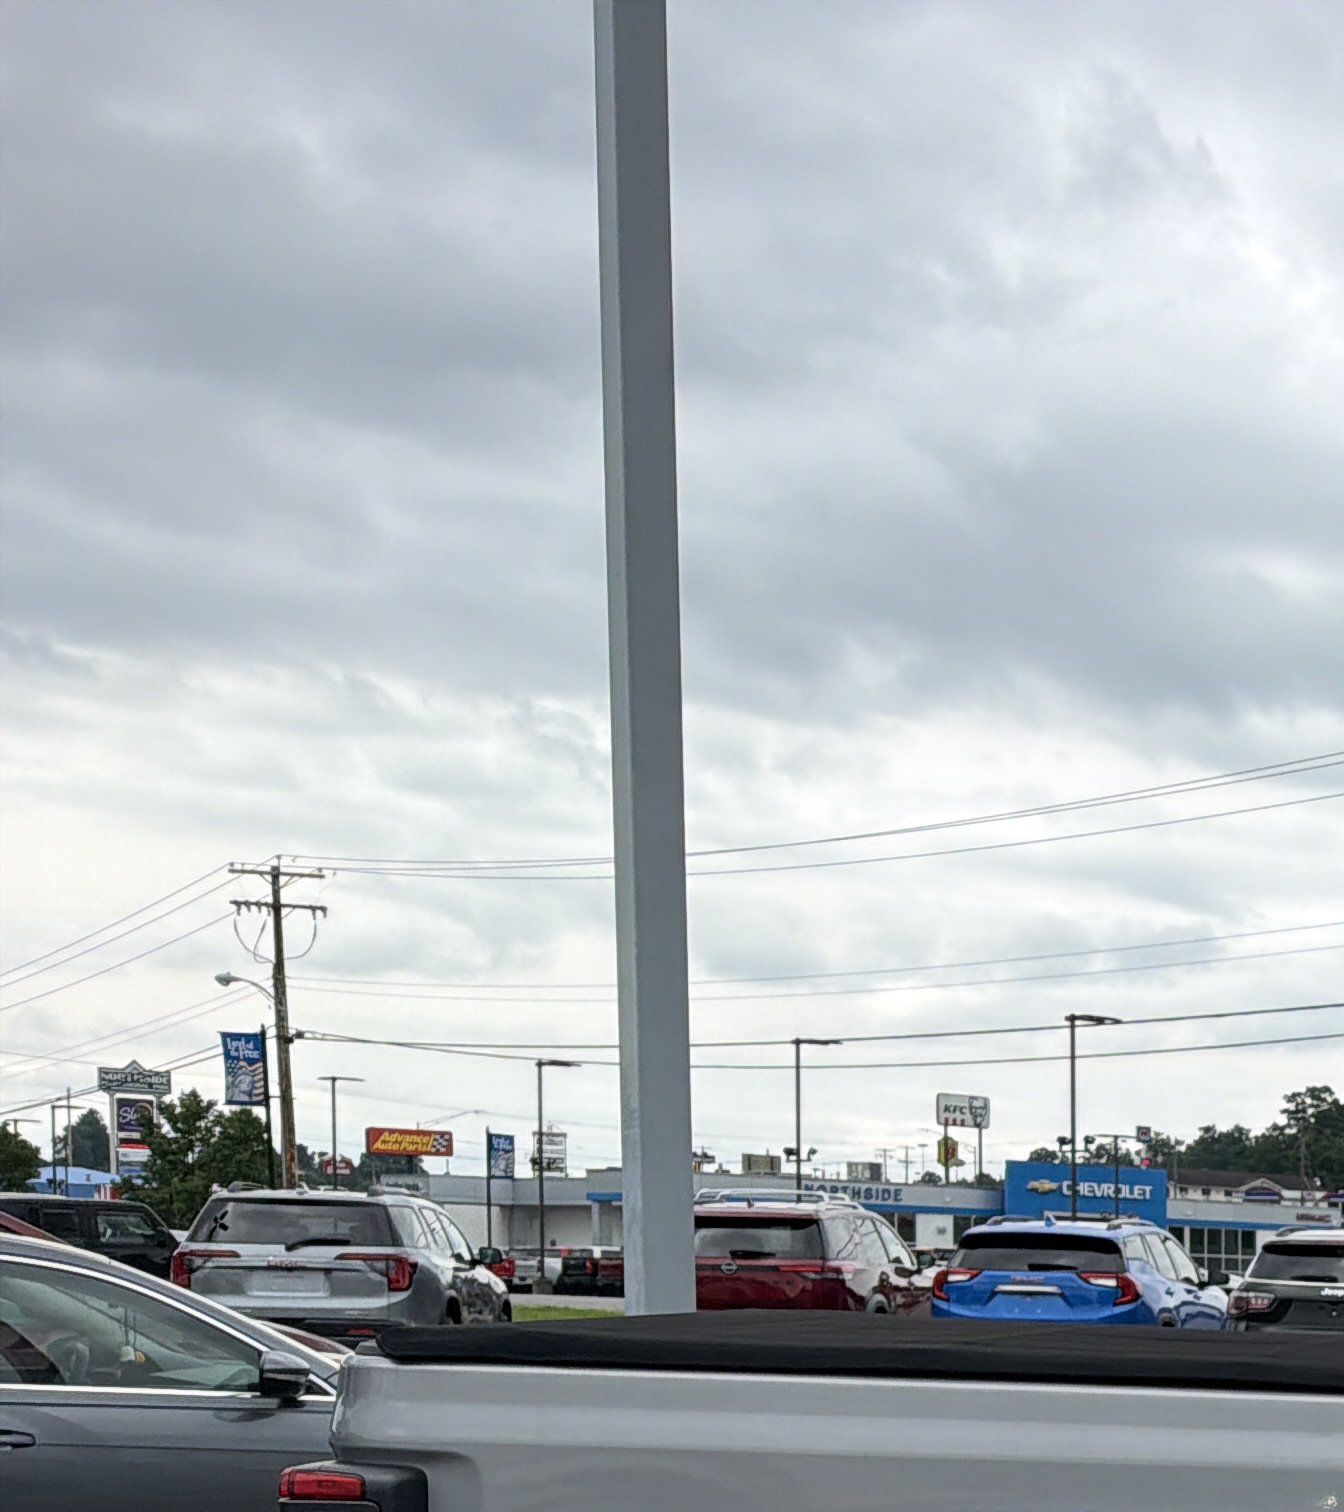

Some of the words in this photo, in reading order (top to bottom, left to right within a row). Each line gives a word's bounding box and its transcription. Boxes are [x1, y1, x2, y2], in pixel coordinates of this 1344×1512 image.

[943, 1104, 967, 1115] KFC
[380, 1131, 430, 1143] Advance
[373, 1139, 399, 1150] Auto
[400, 1140, 427, 1152] Parts
